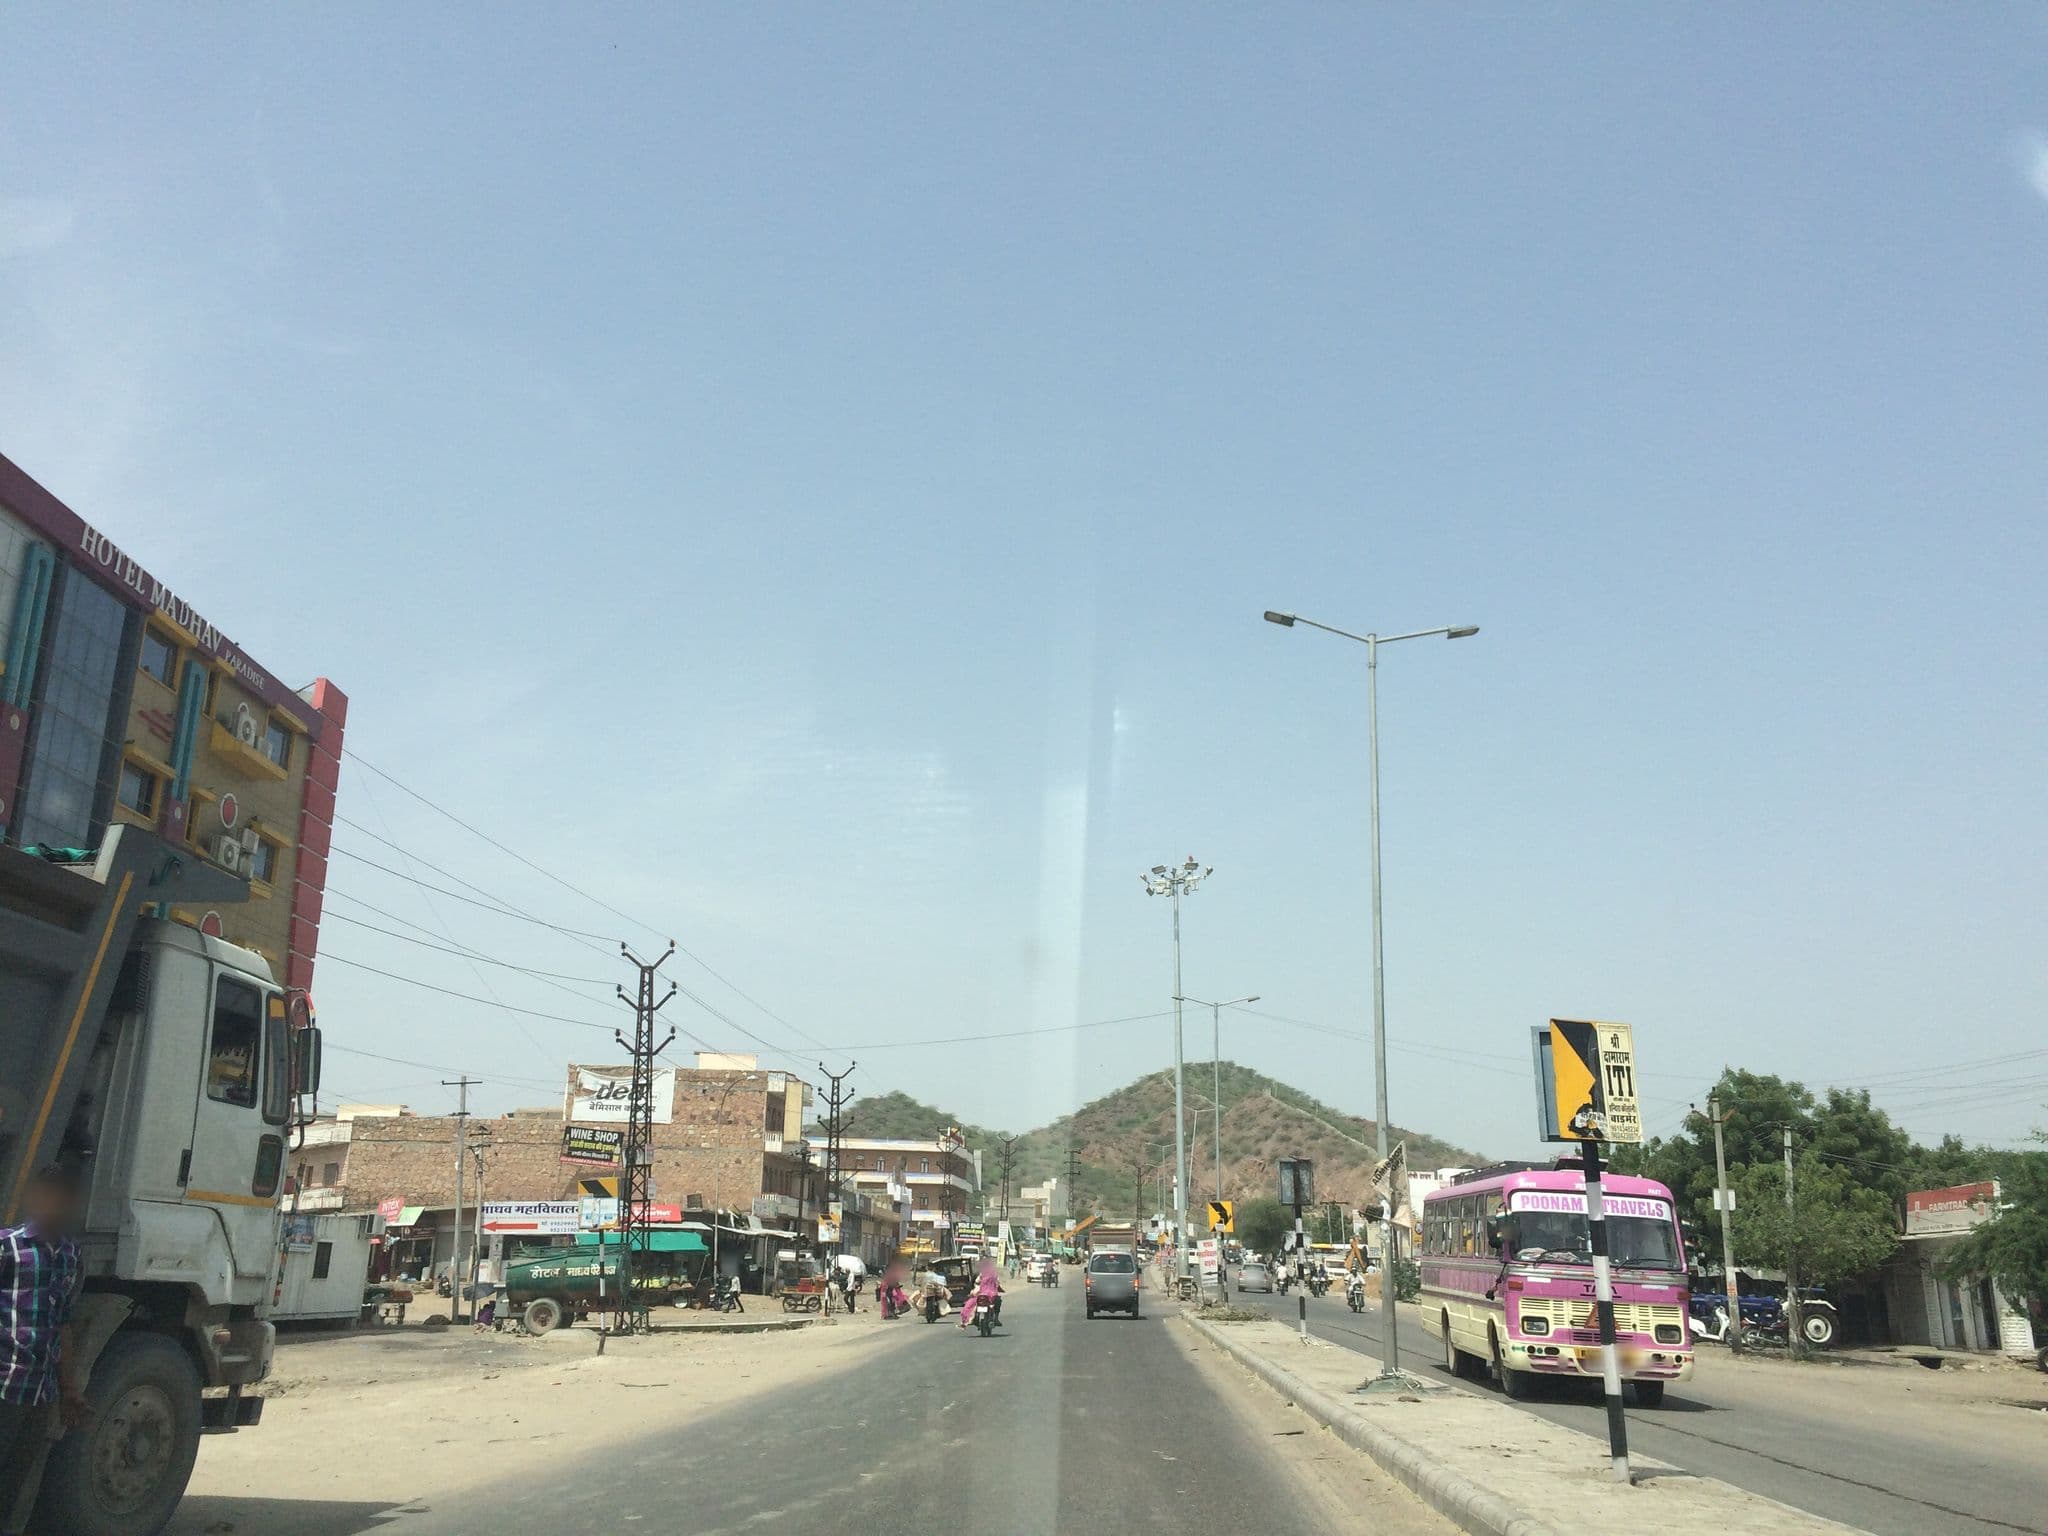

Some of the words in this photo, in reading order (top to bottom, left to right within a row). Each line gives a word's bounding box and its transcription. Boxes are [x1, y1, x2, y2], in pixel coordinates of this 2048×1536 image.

[80, 523, 146, 595] HOTEL
[149, 580, 223, 653] MADHAV
[224, 649, 265, 691] PARADISE
[1610, 1033, 1620, 1049] श्री
[1605, 1065, 1634, 1097] ITI
[589, 1101, 622, 1112] बेमिसाल
[570, 1128, 594, 1140] WINE
[594, 1131, 619, 1143] SHOP
[1521, 1194, 1584, 1212] POONAM
[1602, 1201, 1664, 1218] TRAVELS
[530, 1265, 561, 1279] होटल
[566, 1267, 590, 1277] माधव
